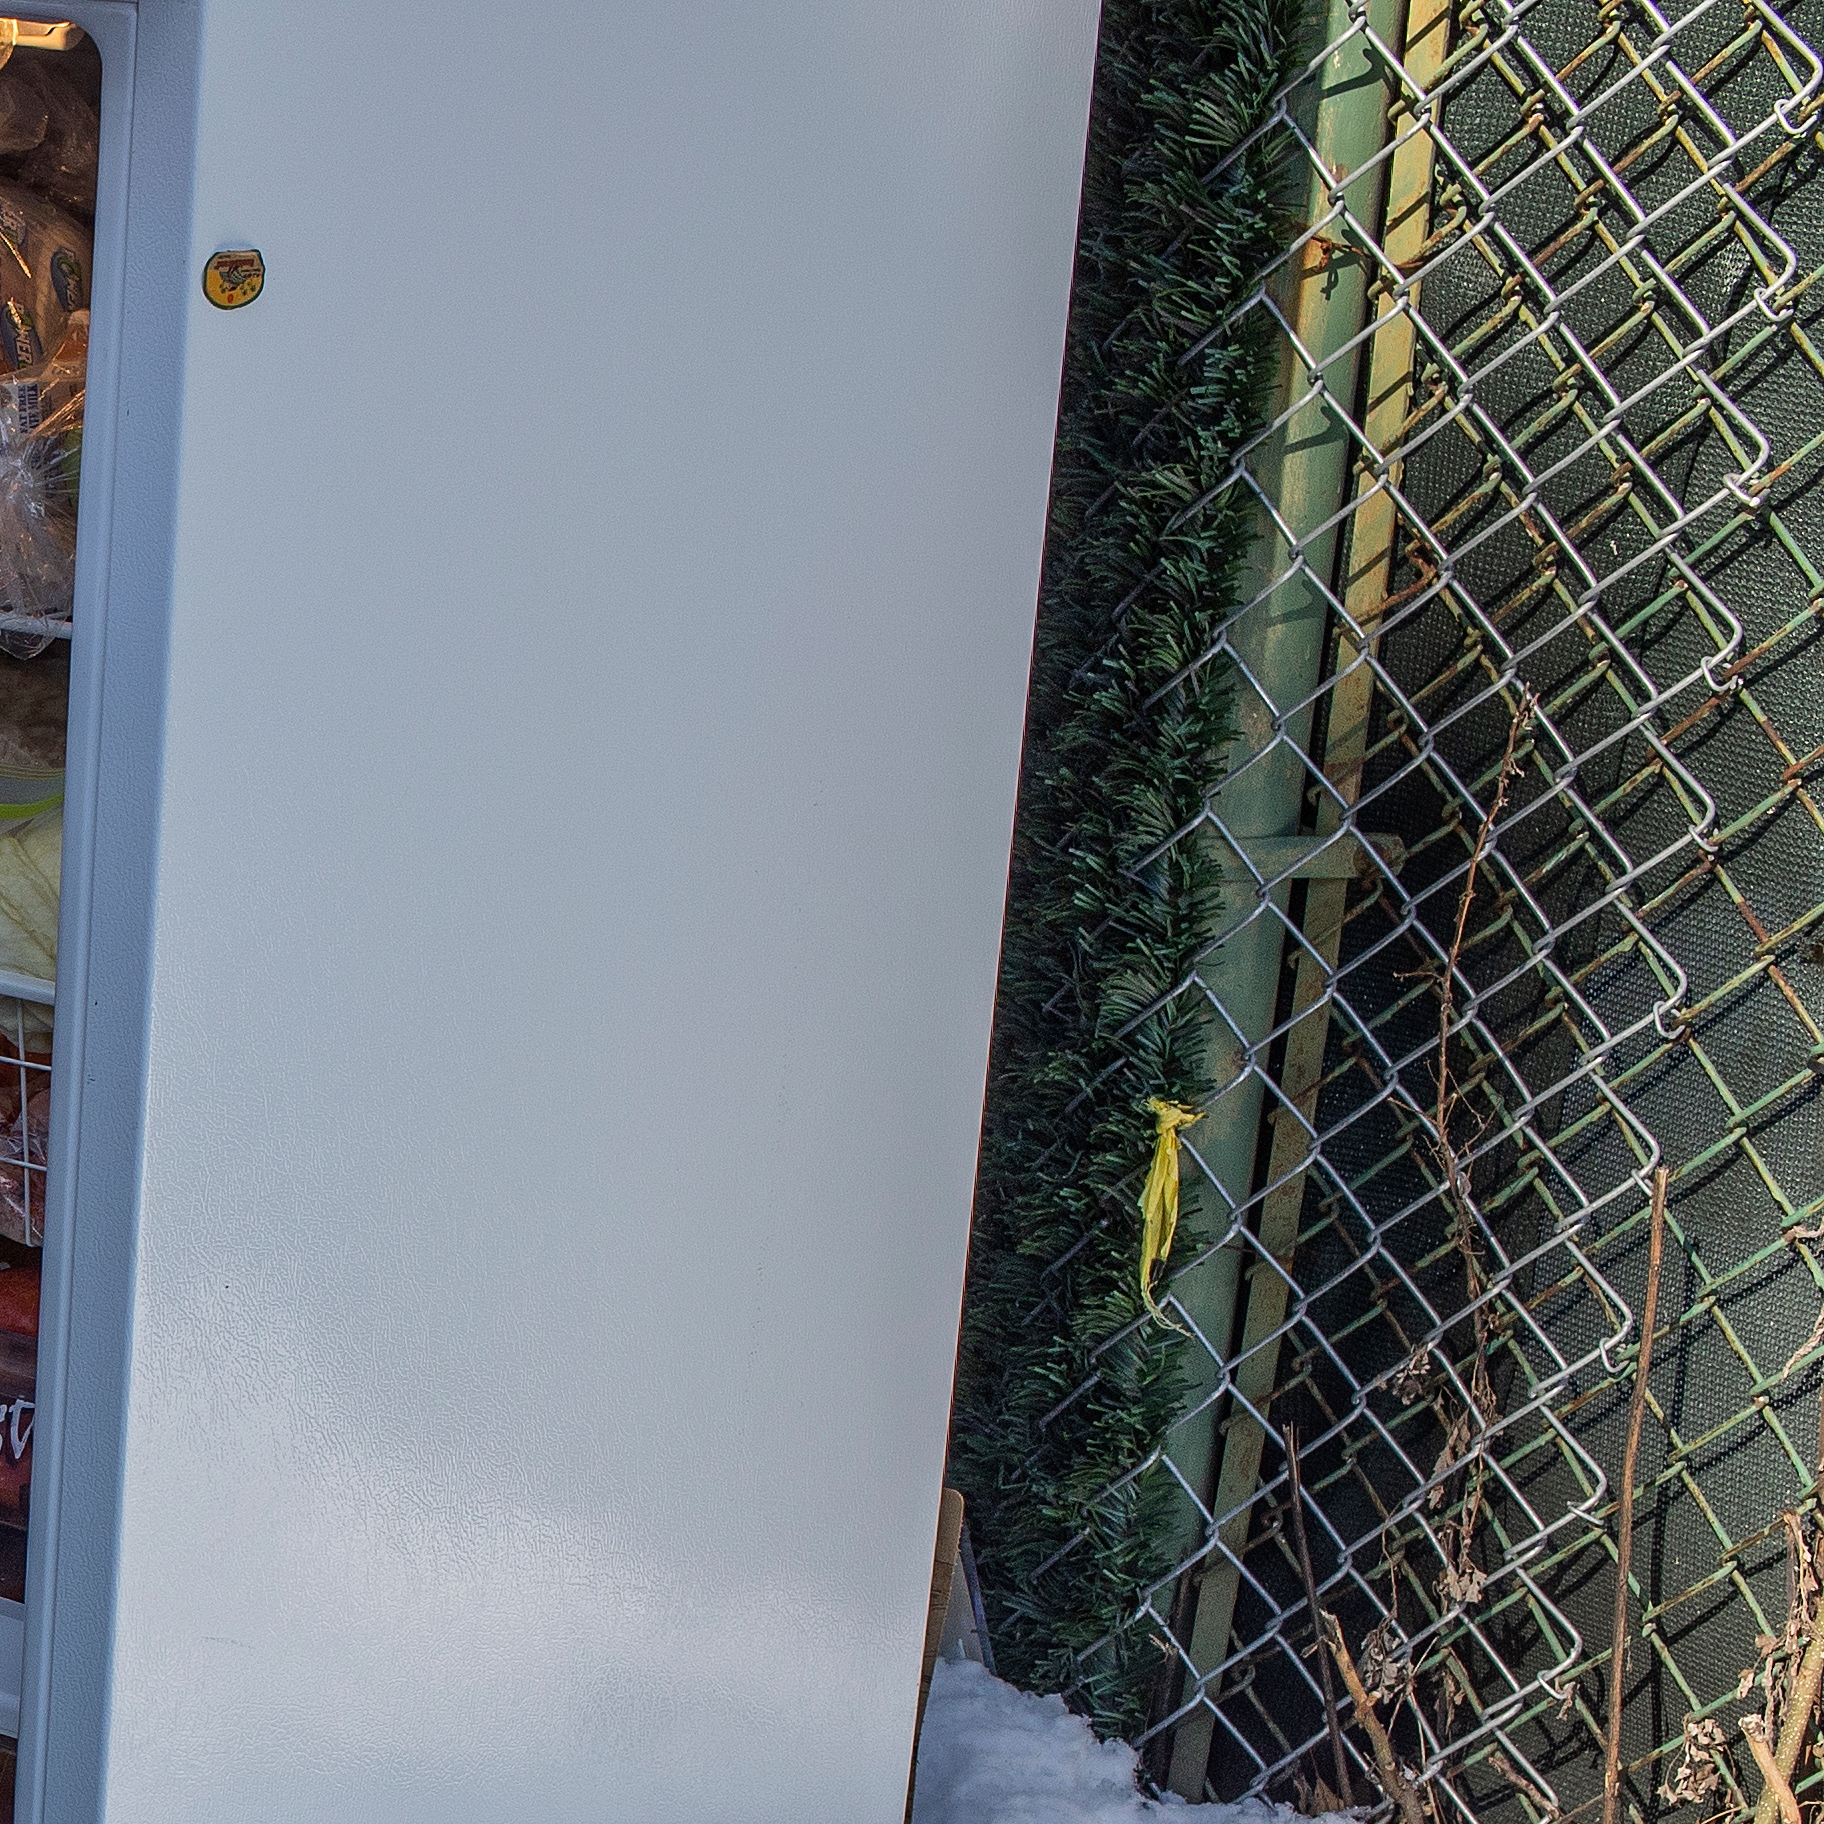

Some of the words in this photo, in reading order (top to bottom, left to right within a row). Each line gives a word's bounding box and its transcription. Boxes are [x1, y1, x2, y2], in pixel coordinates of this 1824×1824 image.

[17, 386, 27, 412] FREE
[27, 384, 39, 409] MILK
[19, 416, 28, 433] FAT
